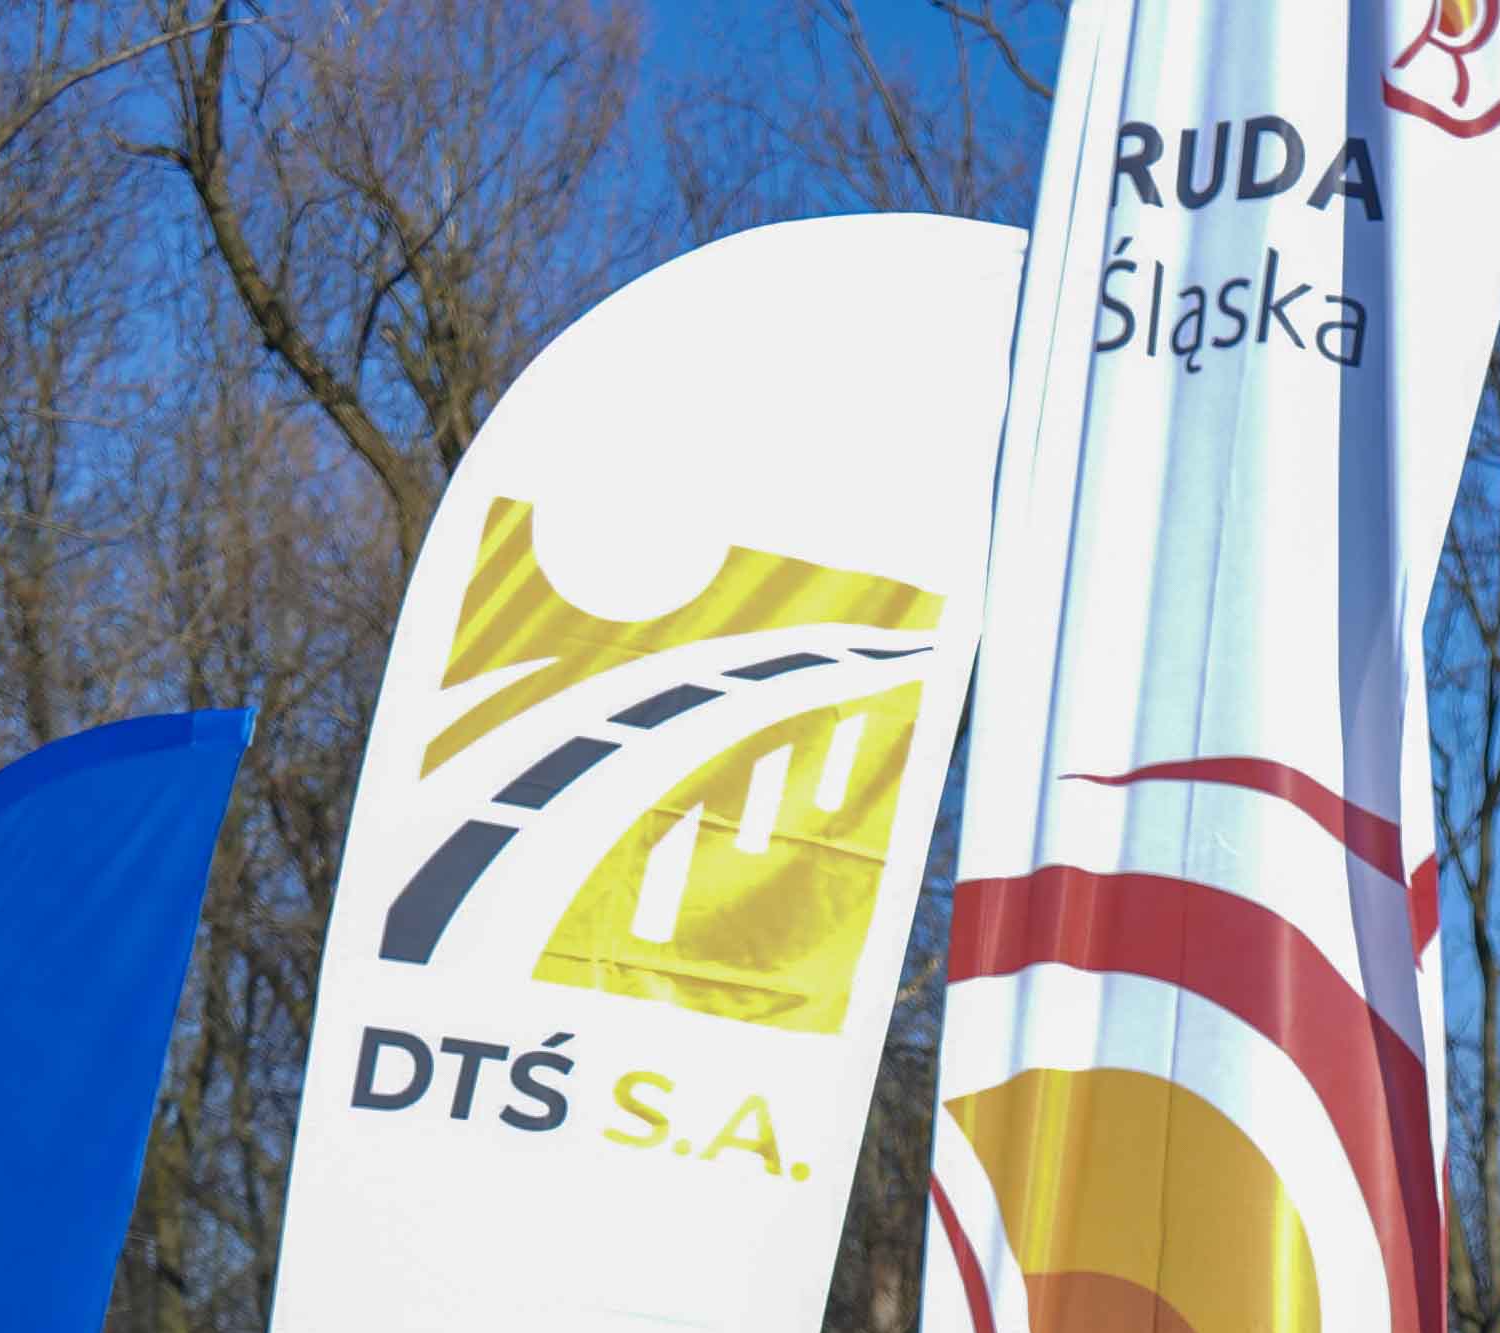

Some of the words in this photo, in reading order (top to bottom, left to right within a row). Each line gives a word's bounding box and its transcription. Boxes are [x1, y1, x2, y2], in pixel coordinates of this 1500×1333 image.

[1110, 114, 1384, 222] RUDA
[1095, 236, 1369, 374] Śląska
[350, 1025, 576, 1132] DTŚ
[602, 1069, 812, 1183] S.A.
